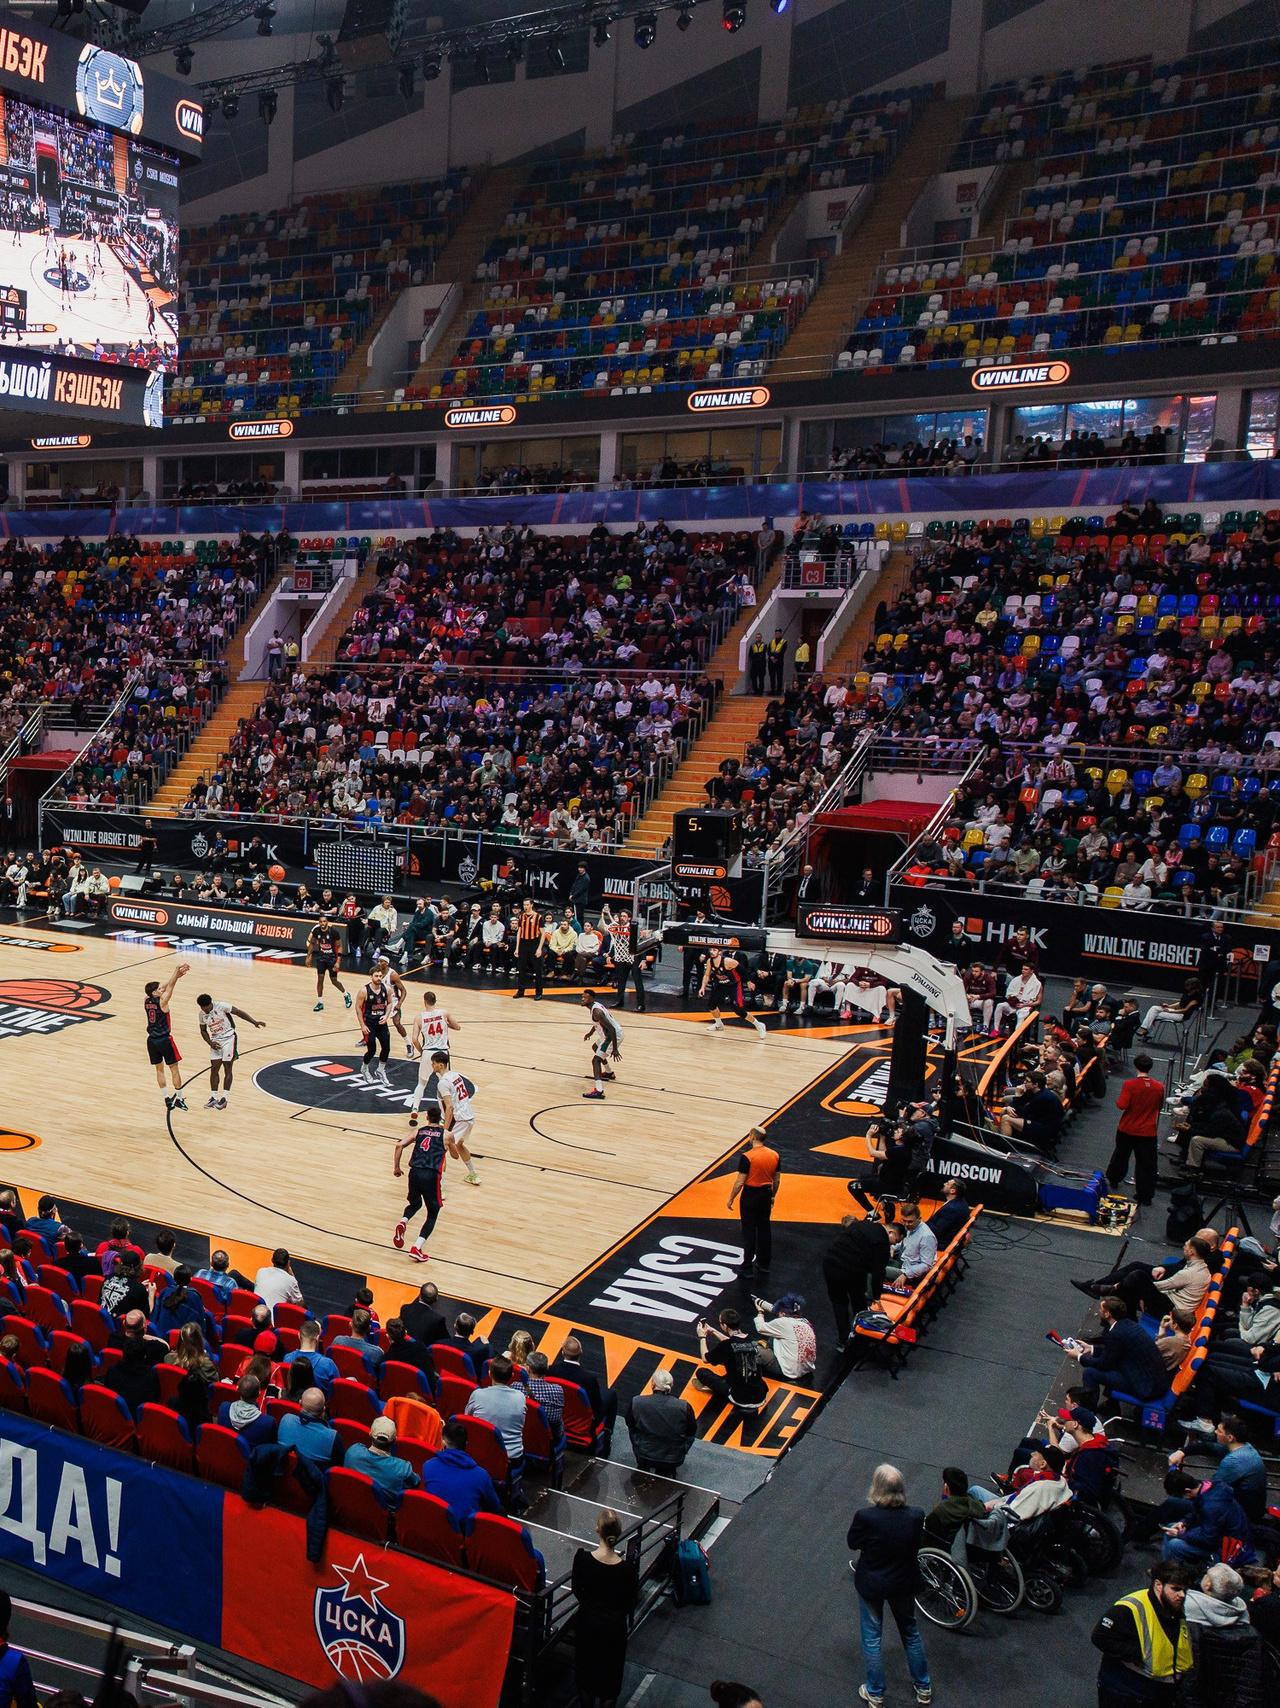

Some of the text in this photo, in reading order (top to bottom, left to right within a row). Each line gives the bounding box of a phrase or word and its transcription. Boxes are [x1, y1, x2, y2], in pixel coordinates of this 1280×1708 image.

[19, 309, 25, 320] 77
[979, 369, 1049, 386] WINLINE
[53, 369, 123, 410] КЭШБЭК
[695, 392, 754, 408] WINLINE
[450, 409, 502, 425] WINLINE
[234, 423, 279, 438] WINLINE
[298, 578, 308, 588] C2
[806, 570, 820, 583] C3
[63, 829, 96, 844] WINLINE
[98, 832, 126, 846] BASKET
[241, 841, 278, 861] НК
[678, 866, 714, 875] WINLINE
[116, 906, 156, 921] WINLINE
[348, 907, 354, 916] 5
[176, 913, 294, 940] САМЫЙ БОЛЬШОЙ КЭШБЭК
[812, 916, 873, 931] WINLINE
[914, 916, 933, 925] ЦСКА
[105, 929, 310, 960] MOSCOW
[688, 936, 732, 946] WINLINE BASKET CUP
[1084, 933, 1202, 966] WINLINE BASKET
[910, 972, 940, 999] SPALDING
[148, 1010, 156, 1023] 9
[428, 1022, 444, 1036] 44
[456, 1084, 469, 1101] 23
[420, 1136, 431, 1152] 4
[938, 1158, 1003, 1185] MOSCOW
[589, 1235, 746, 1323] CSKA
[324, 1600, 395, 1648] ЦСКА
